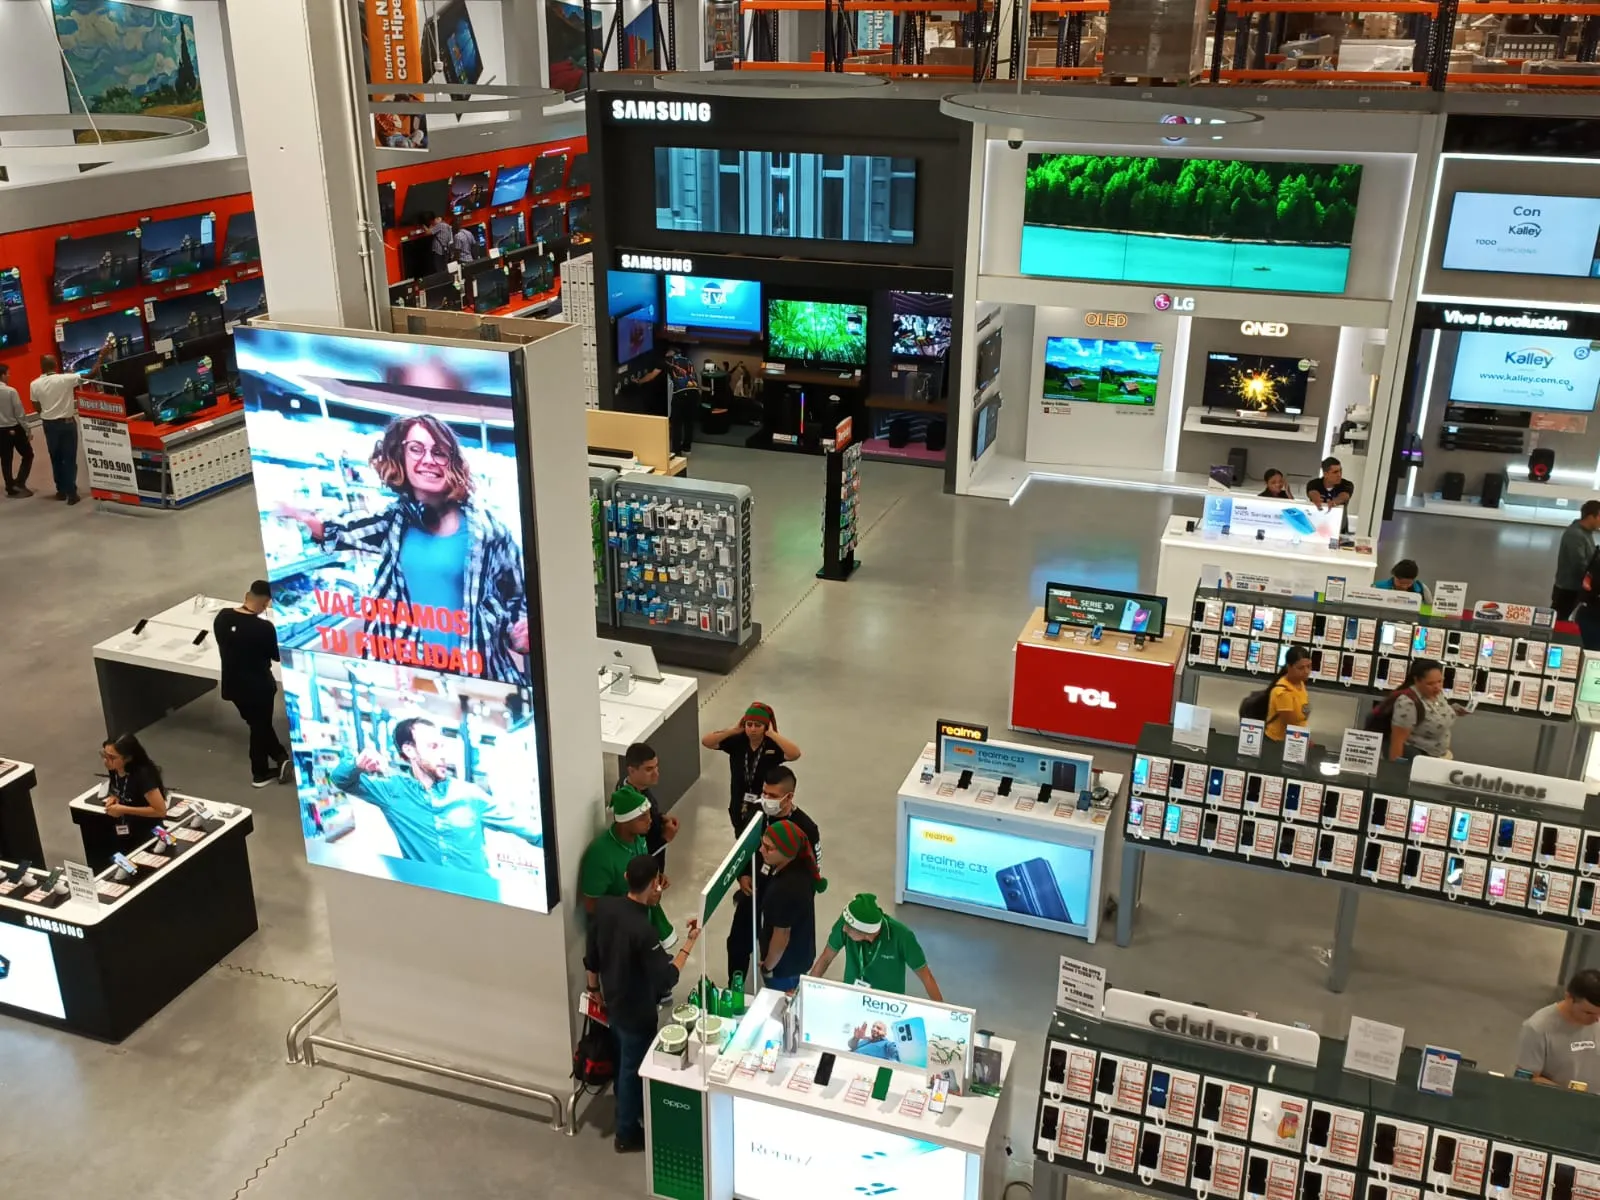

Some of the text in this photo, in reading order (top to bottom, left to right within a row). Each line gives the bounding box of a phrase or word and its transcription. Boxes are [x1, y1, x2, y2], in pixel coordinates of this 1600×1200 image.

[395, 45, 407, 80] con
[612, 99, 711, 122] SAMSUNG
[1513, 206, 1541, 217] Con
[1508, 223, 1542, 238] Kalley
[621, 254, 692, 273] SAMSUNG
[1173, 297, 1195, 311] LG
[1085, 312, 1128, 328] OLED
[1240, 320, 1289, 337] QNED
[1443, 309, 1568, 331] Vive la evolución
[1504, 349, 1555, 369] Kalley
[1479, 371, 1570, 386] www.kalley.com.co
[741, 497, 751, 630] ACCESORIOS
[314, 587, 470, 637] VALORAMOS
[1057, 597, 1079, 606] TCL
[1080, 600, 1102, 609] SERIE
[316, 626, 484, 675] TU FIDELIDAD
[1063, 685, 1117, 709] TCL
[941, 726, 982, 739] realme
[1448, 769, 1547, 799] Celulares
[723, 850, 746, 886] oppo
[920, 852, 965, 870] realme
[25, 914, 84, 939] SAMSUNG
[862, 995, 908, 1015] Reno7
[950, 1011, 969, 1023] 5G
[1148, 1008, 1269, 1052] Celulares
[663, 1098, 691, 1111] oppo
[750, 1141, 813, 1167] Reno7
